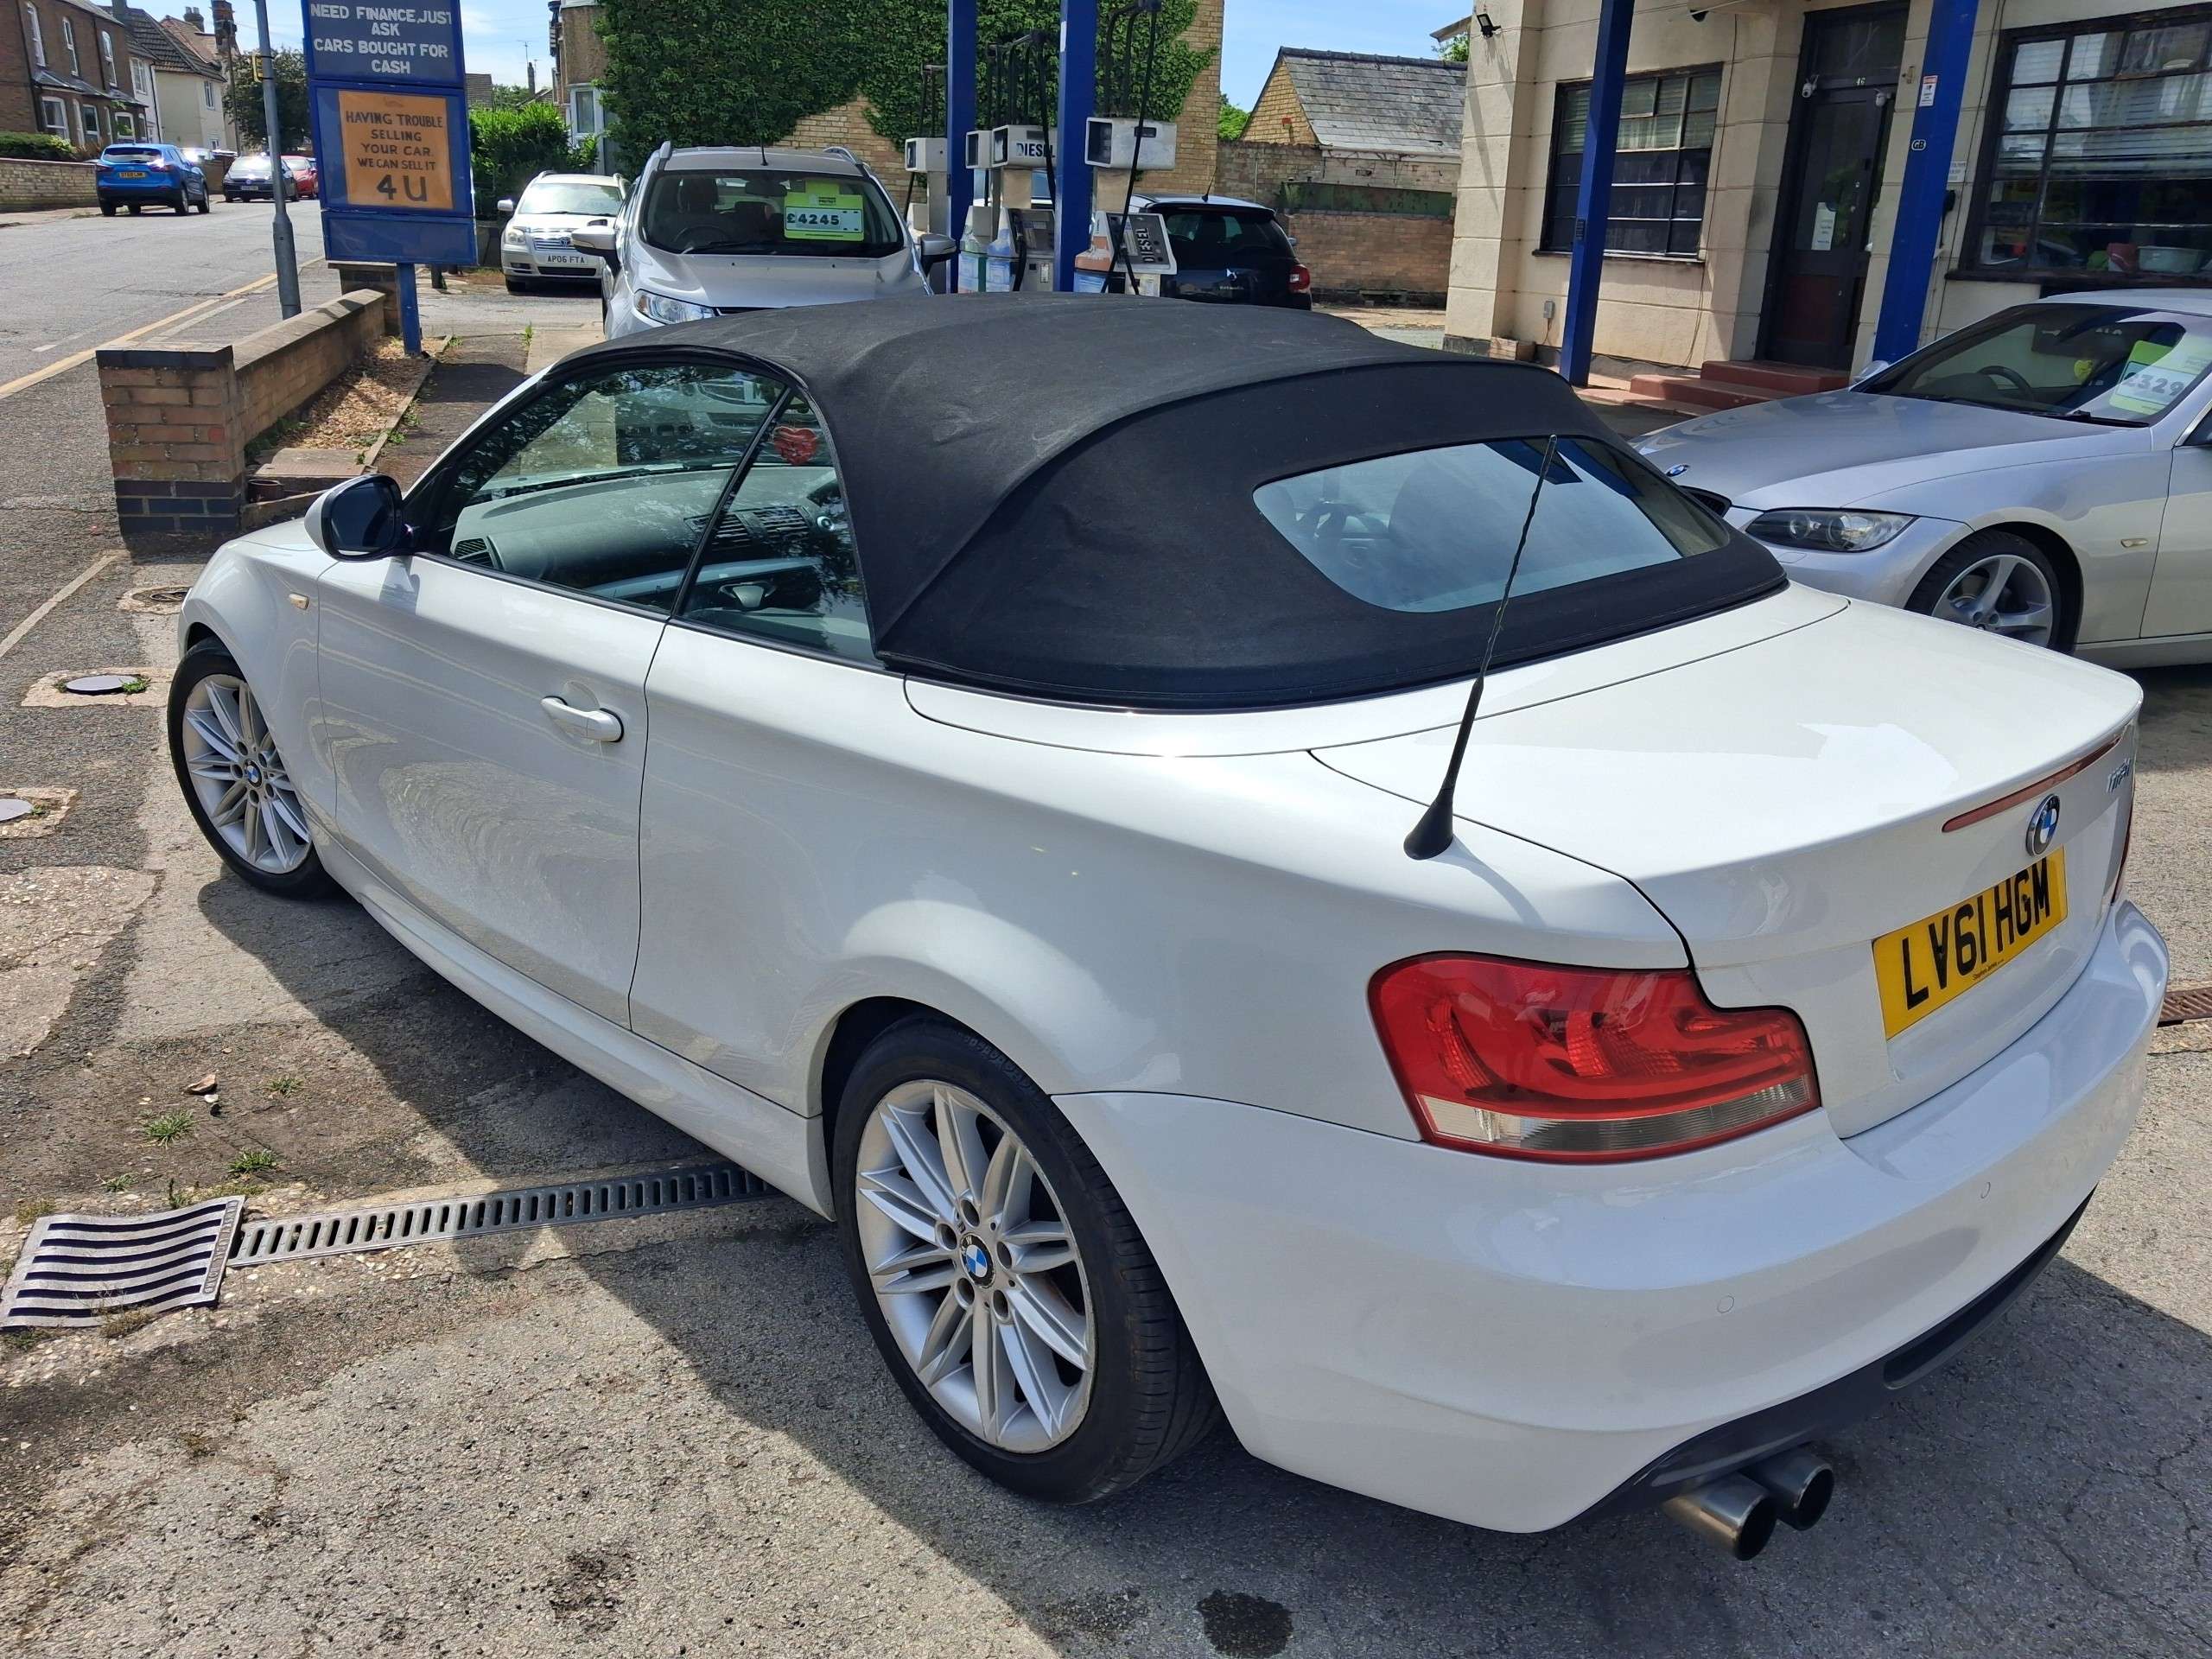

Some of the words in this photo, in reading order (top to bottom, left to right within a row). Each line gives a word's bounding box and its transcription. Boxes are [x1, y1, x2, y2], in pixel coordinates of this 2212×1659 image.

[310, 3, 349, 19] NEED
[372, 22, 400, 36] ASK
[314, 38, 353, 54] CARS
[358, 41, 416, 56] BOUGHT
[420, 44, 448, 58] FOR
[372, 60, 411, 74] CASH
[346, 111, 392, 124] HAVING
[397, 113, 443, 128] TROUBLE
[371, 129, 422, 141] SELLING
[361, 143, 397, 155] YOUR
[357, 157, 373, 168] WE
[376, 158, 398, 168] CAN
[401, 160, 423, 170] SELL
[425, 162, 435, 171] IT
[787, 213, 840, 225] £4245
[1135, 228, 1155, 263] DIESEL
[547, 255, 567, 264] AP06
[1902, 895, 1987, 1011] LV61
[1993, 856, 2050, 954] HGM
